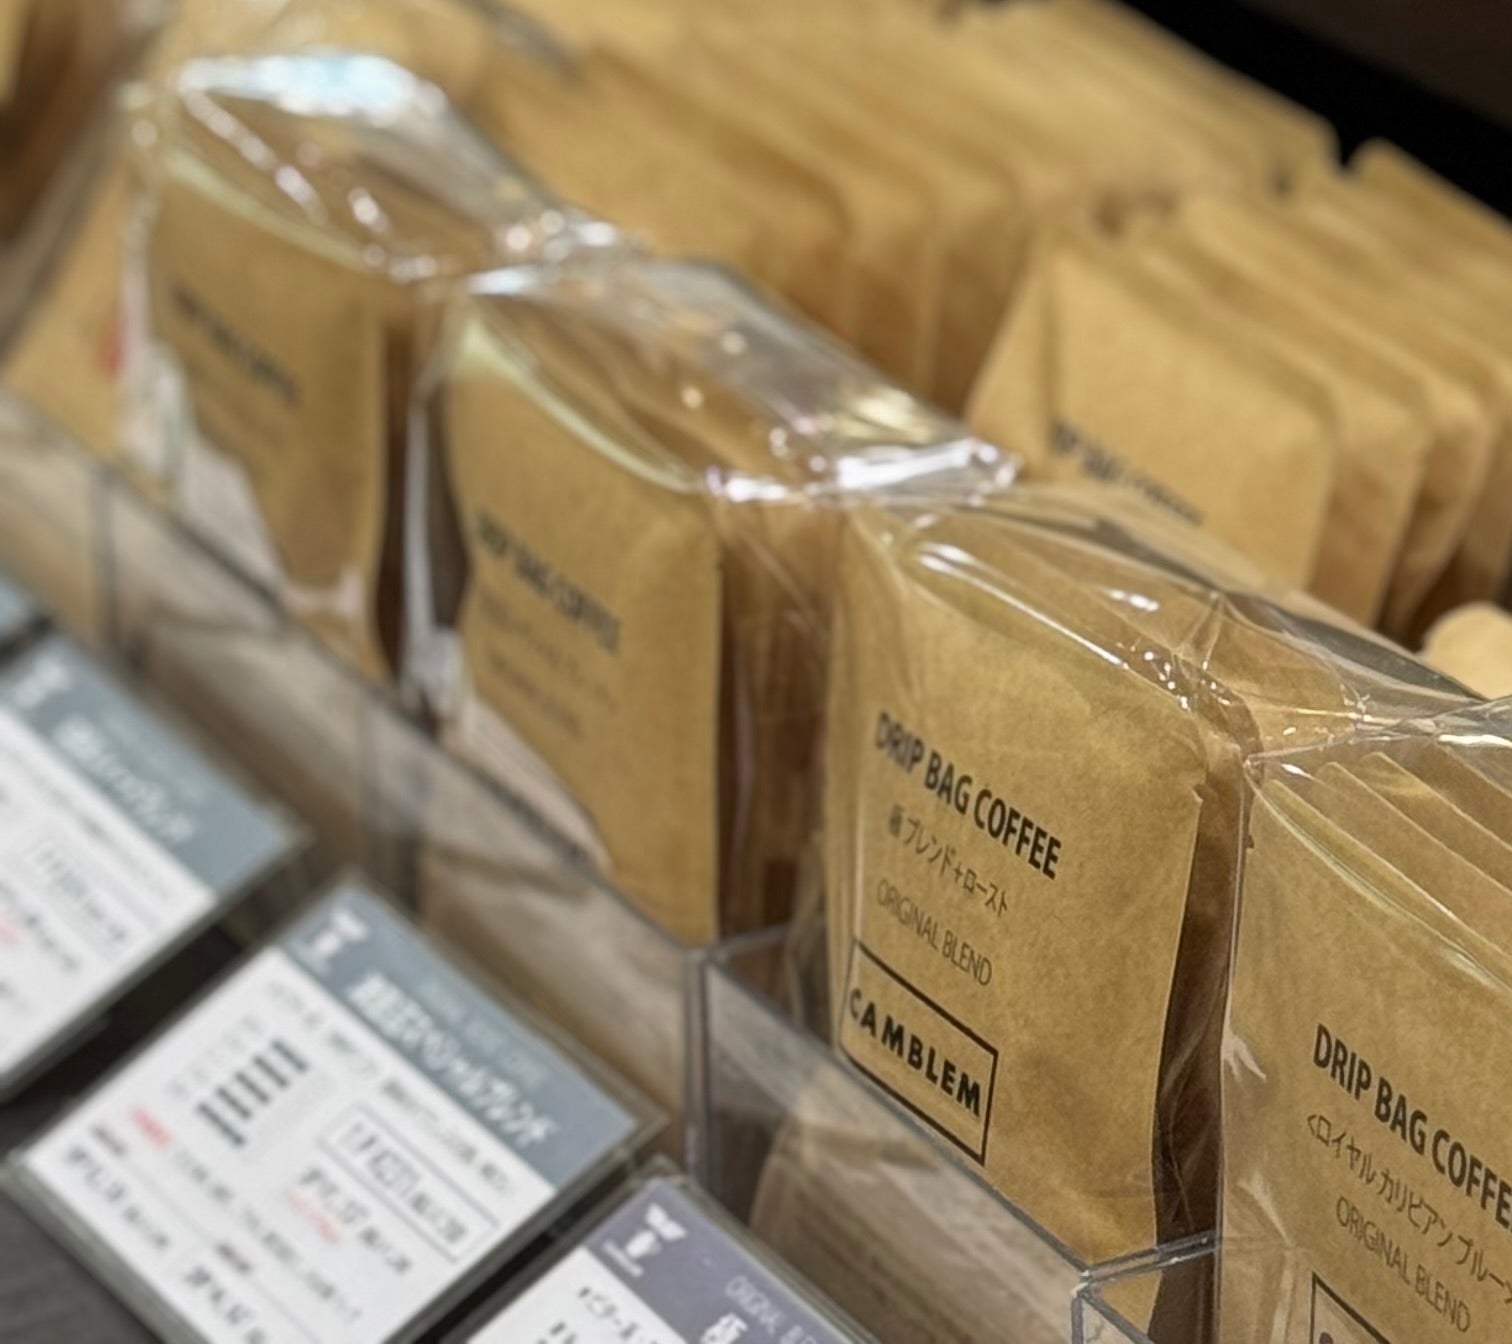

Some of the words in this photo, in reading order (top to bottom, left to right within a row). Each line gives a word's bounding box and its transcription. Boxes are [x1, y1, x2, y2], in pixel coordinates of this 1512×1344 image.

[875, 711, 924, 774] DRIP
[923, 749, 974, 814] BAG
[972, 787, 1063, 881] COFFEE
[877, 878, 939, 952] ORIGINAL
[942, 930, 993, 986] BLEND
[848, 987, 983, 1118] CAMBLEM
[1312, 1023, 1372, 1101] DRIP
[1374, 1077, 1427, 1155] BAG
[1336, 1196, 1411, 1285] ORIGINAL
[1416, 1263, 1472, 1334] BLEND
